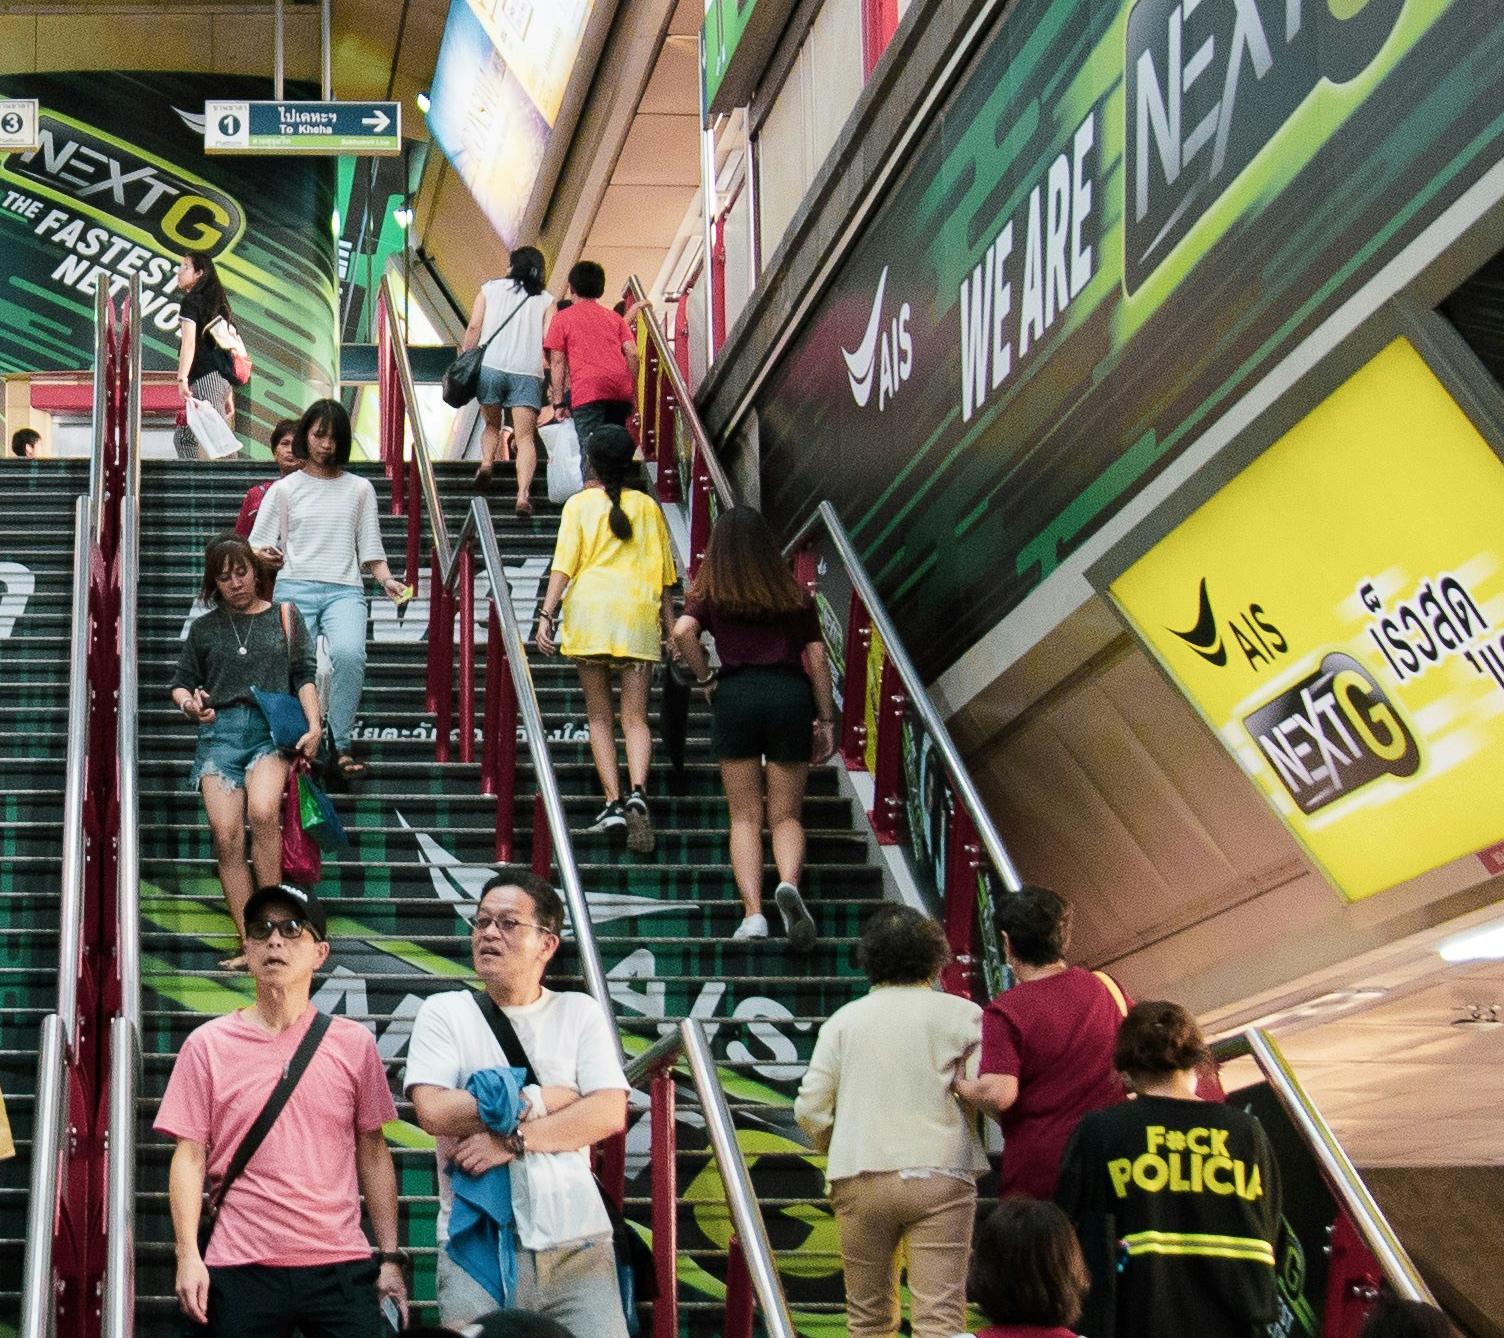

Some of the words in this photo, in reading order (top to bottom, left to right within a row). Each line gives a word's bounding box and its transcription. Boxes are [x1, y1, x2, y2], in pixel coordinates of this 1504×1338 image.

[5, 113, 20, 132] 3
[279, 124, 294, 134] To
[298, 124, 333, 135] Kheha
[1, 190, 44, 219] THE
[34, 208, 182, 294] FASTEST
[958, 233, 1014, 423] WE
[1019, 119, 1096, 357] ARE
[878, 299, 913, 411] AIS
[1232, 601, 1289, 672] AIS
